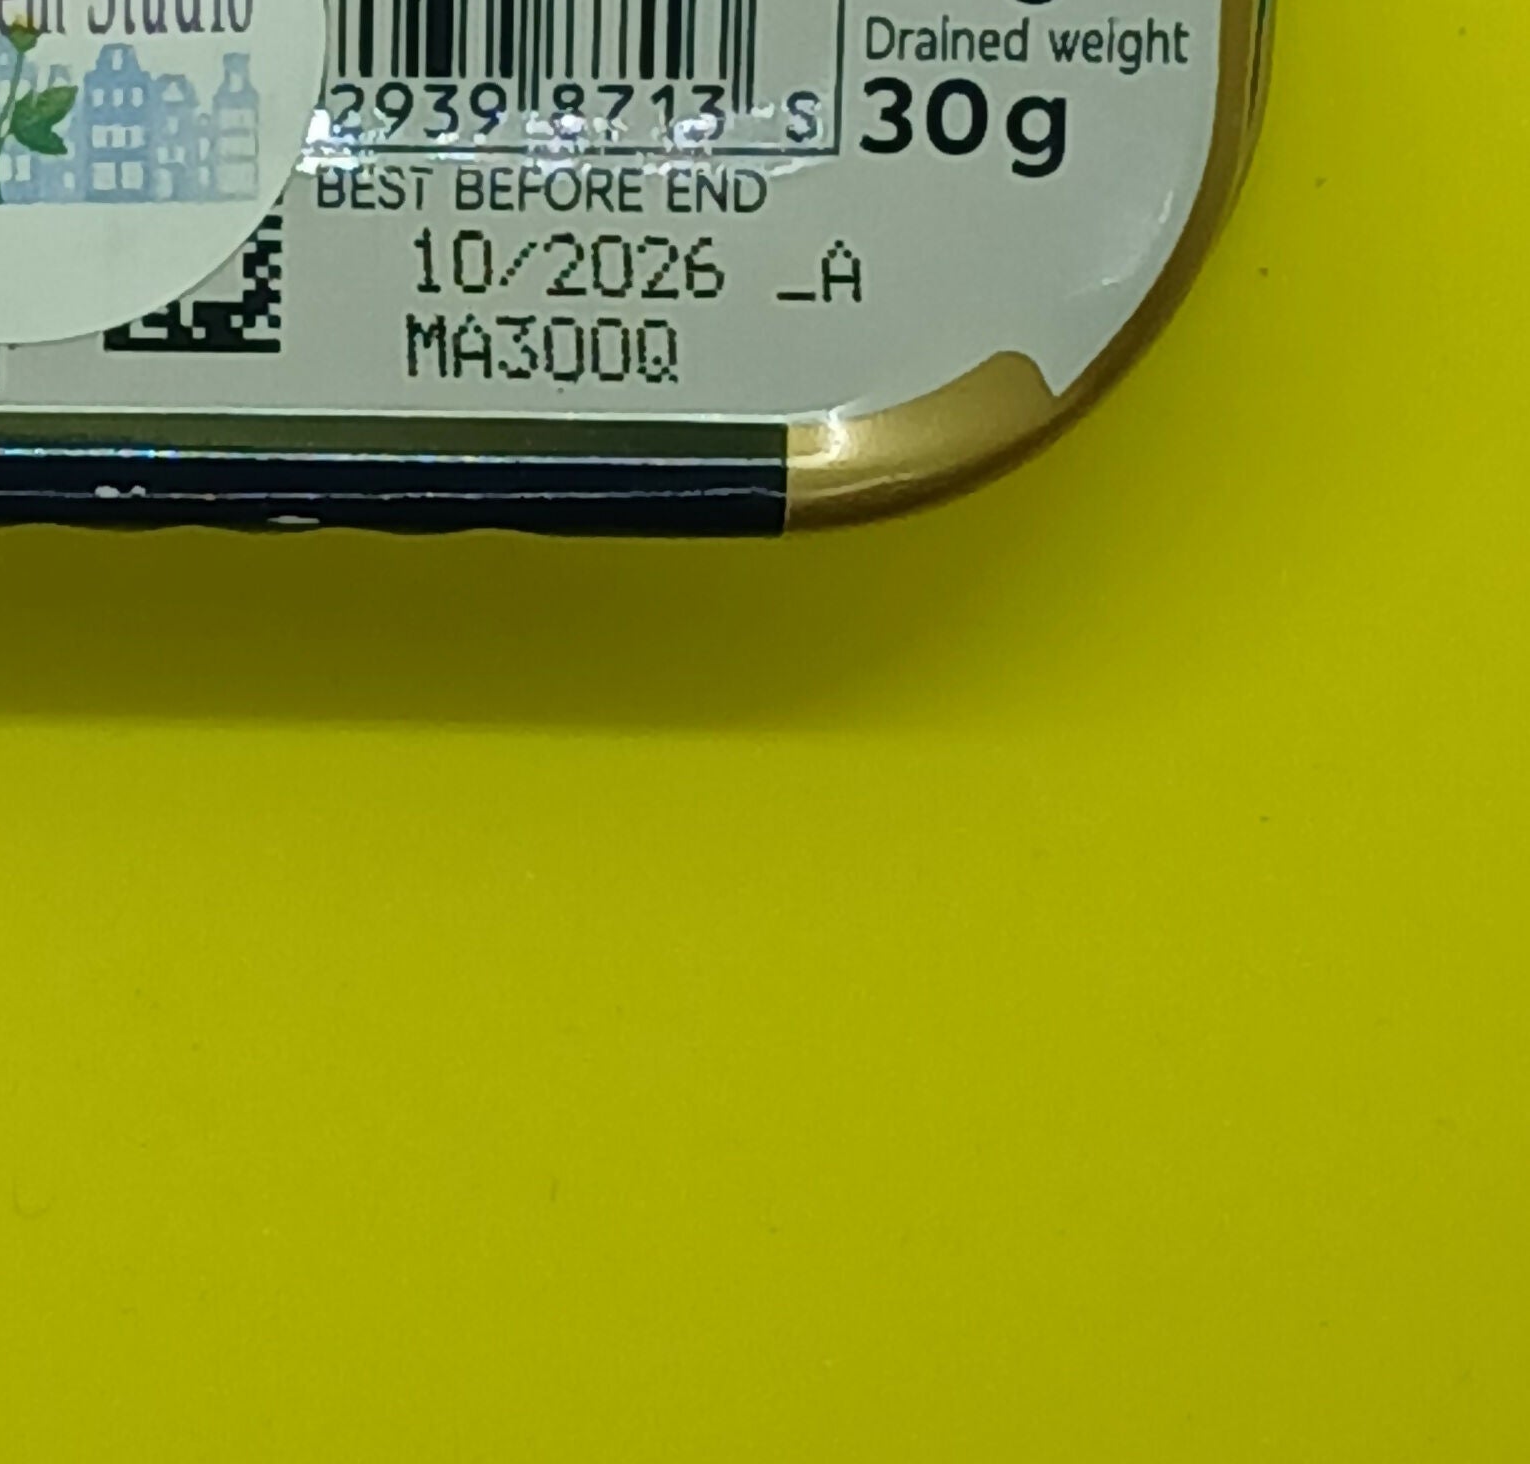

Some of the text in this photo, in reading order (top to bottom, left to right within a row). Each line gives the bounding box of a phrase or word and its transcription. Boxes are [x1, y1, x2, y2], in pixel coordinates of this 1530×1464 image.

[866, 14, 1189, 74] Drained weight
[860, 77, 1066, 178] 30g
[317, 168, 767, 212] BEST BEFORE END
[415, 228, 724, 298] 10/2026
